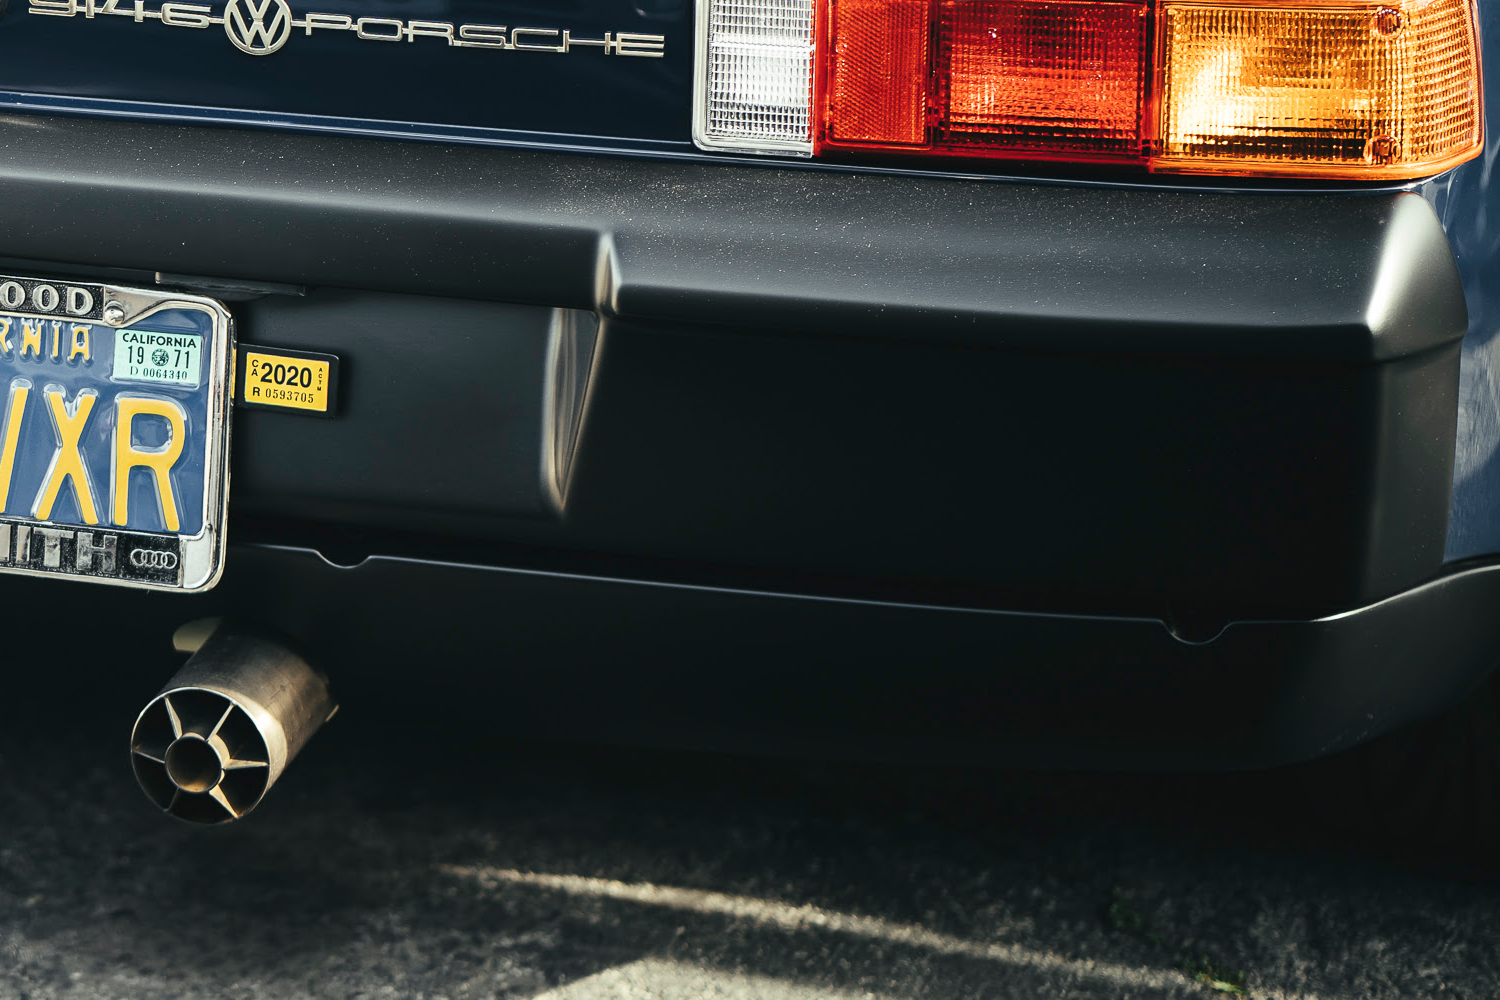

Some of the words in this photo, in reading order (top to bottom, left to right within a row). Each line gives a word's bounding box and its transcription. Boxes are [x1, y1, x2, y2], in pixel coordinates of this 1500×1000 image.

[304, 12, 666, 58] PORSCHE
[122, 332, 197, 349] CALIFORNIA
[127, 345, 145, 365] 19
[174, 349, 190, 369] 71
[130, 365, 139, 376] D
[142, 367, 188, 381] 0064340
[260, 362, 313, 389] 2020
[252, 386, 261, 397] R
[265, 387, 314, 404] 0593705
